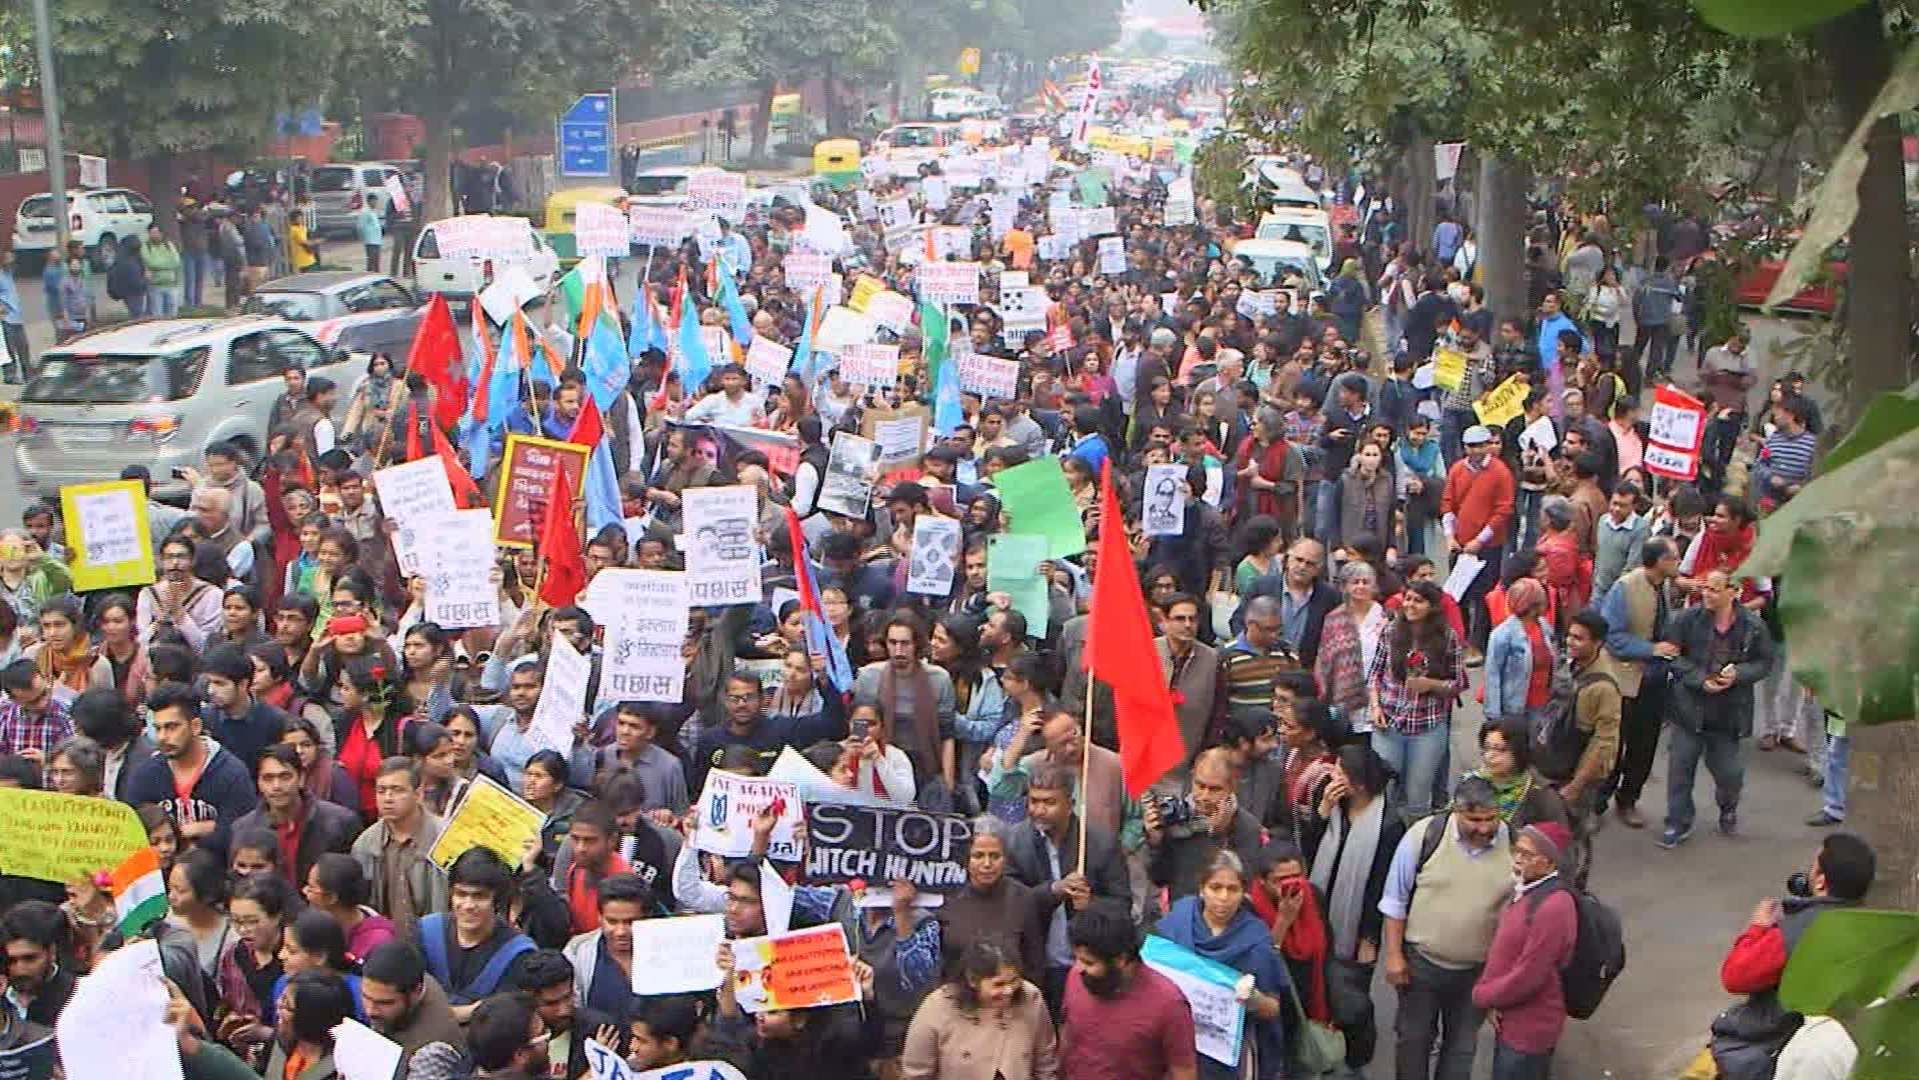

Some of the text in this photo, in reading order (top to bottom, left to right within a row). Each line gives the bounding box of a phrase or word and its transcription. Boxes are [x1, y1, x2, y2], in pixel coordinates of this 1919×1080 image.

[737, 782, 796, 799] AGAINST
[812, 803, 971, 860] STOP
[806, 848, 876, 878] WITCH
